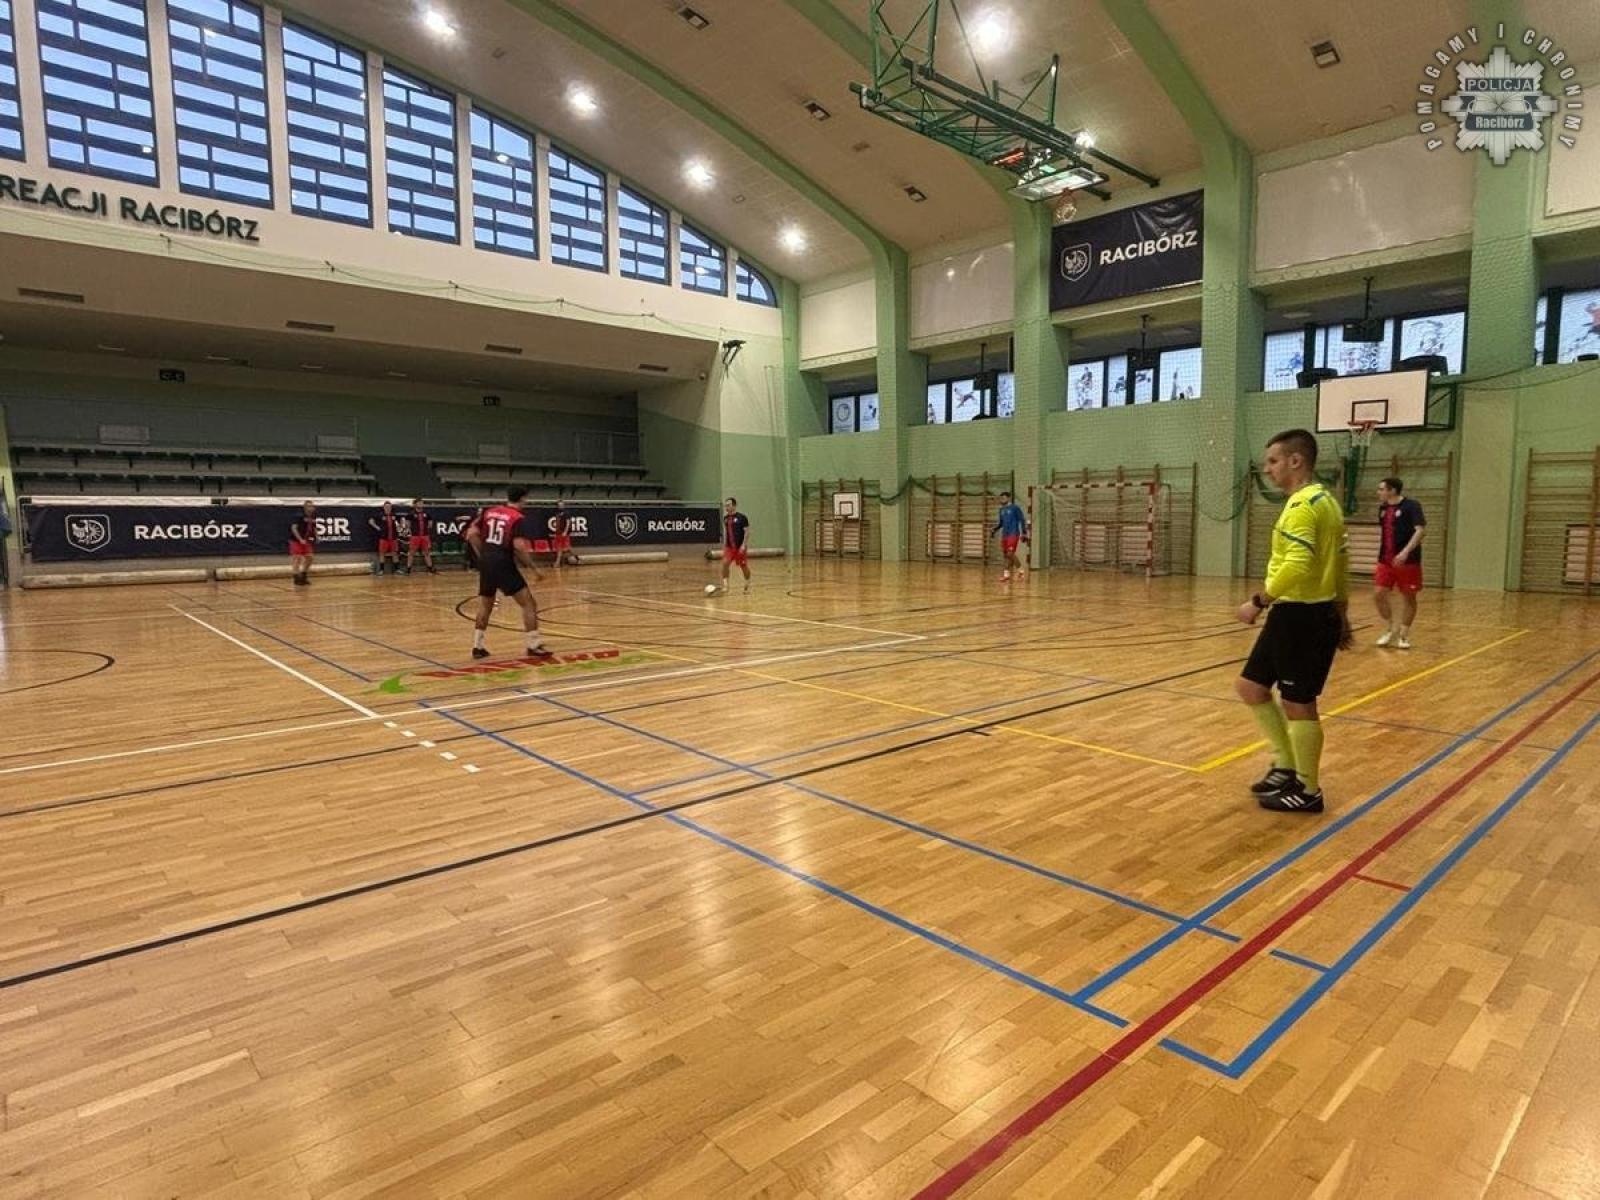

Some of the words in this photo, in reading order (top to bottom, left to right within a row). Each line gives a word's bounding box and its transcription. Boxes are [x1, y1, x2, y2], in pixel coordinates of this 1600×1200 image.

[120, 196, 259, 241] RACIBÓRZ
[1100, 230, 1198, 265] RACIBÓRZ
[134, 519, 249, 540] RACIBÓRZ
[315, 516, 351, 536] SiR
[486, 518, 506, 545] 15
[647, 516, 705, 532] RACIBÓRZ
